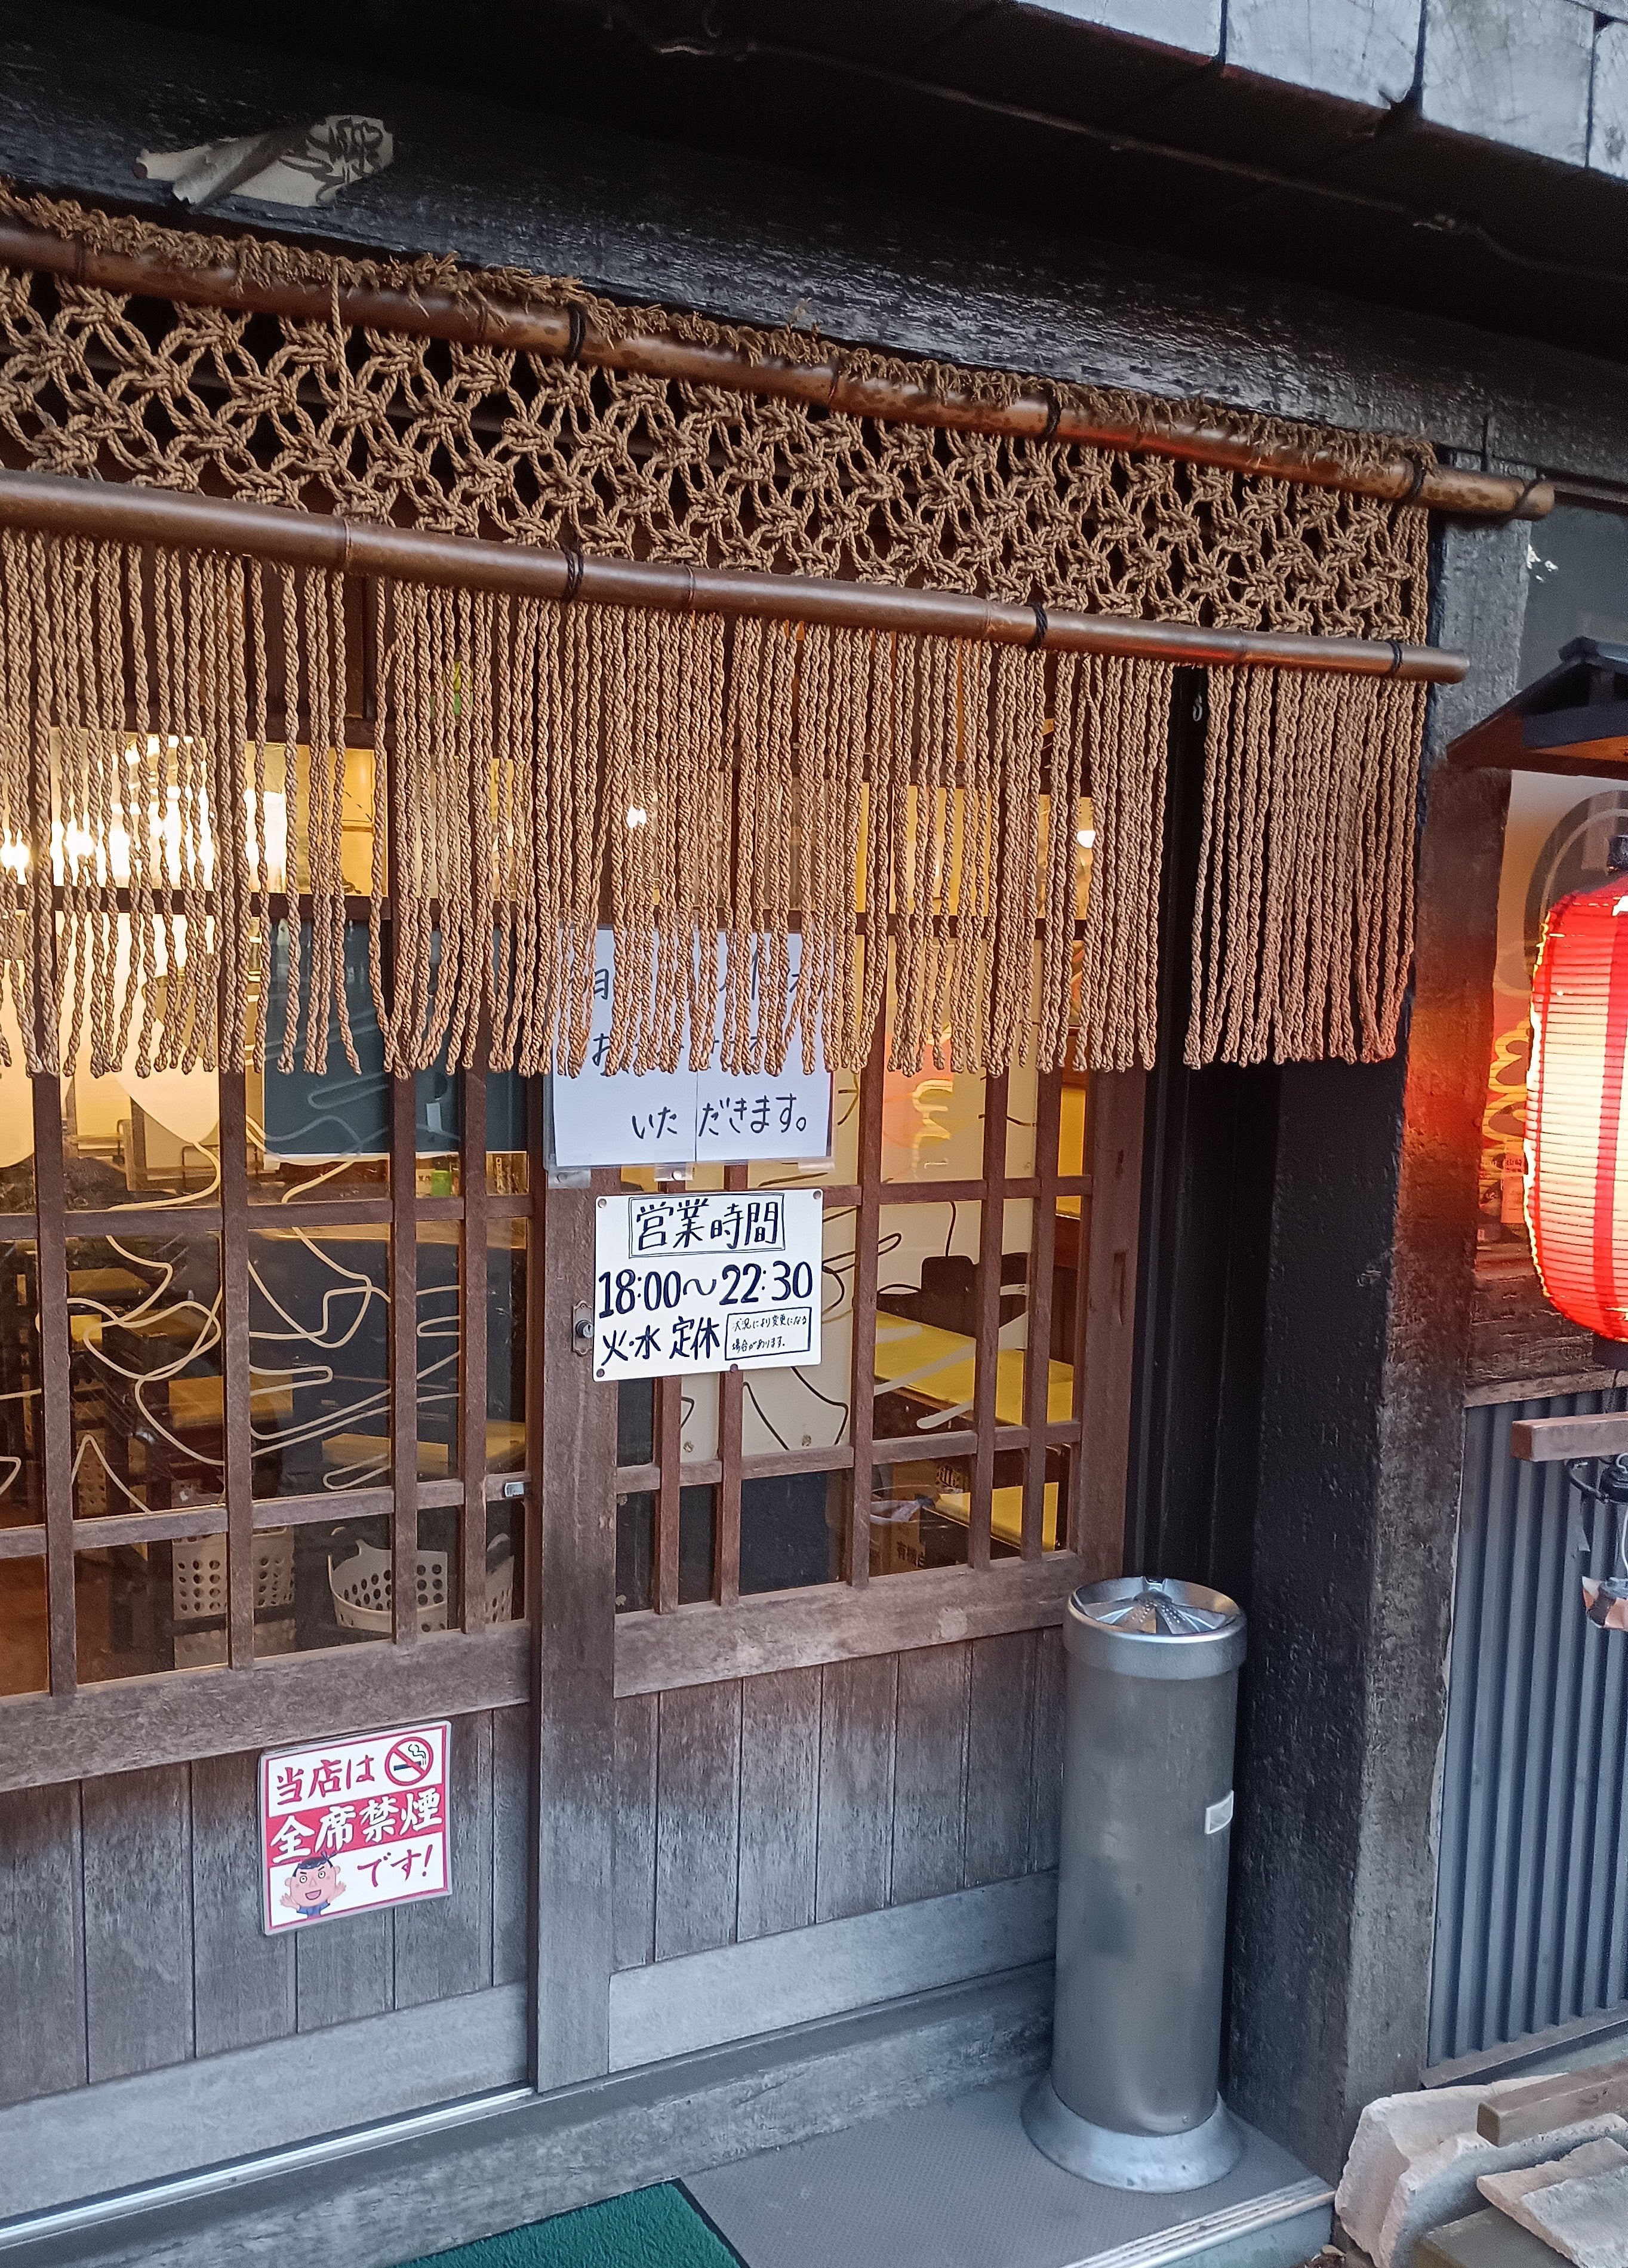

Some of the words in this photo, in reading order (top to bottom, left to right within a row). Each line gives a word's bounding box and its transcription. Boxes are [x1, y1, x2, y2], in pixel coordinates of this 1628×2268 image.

[636, 1198, 778, 1250] 営業時間
[276, 1754, 375, 1806] 当店は
[270, 1787, 442, 1864] 全席禁煙
